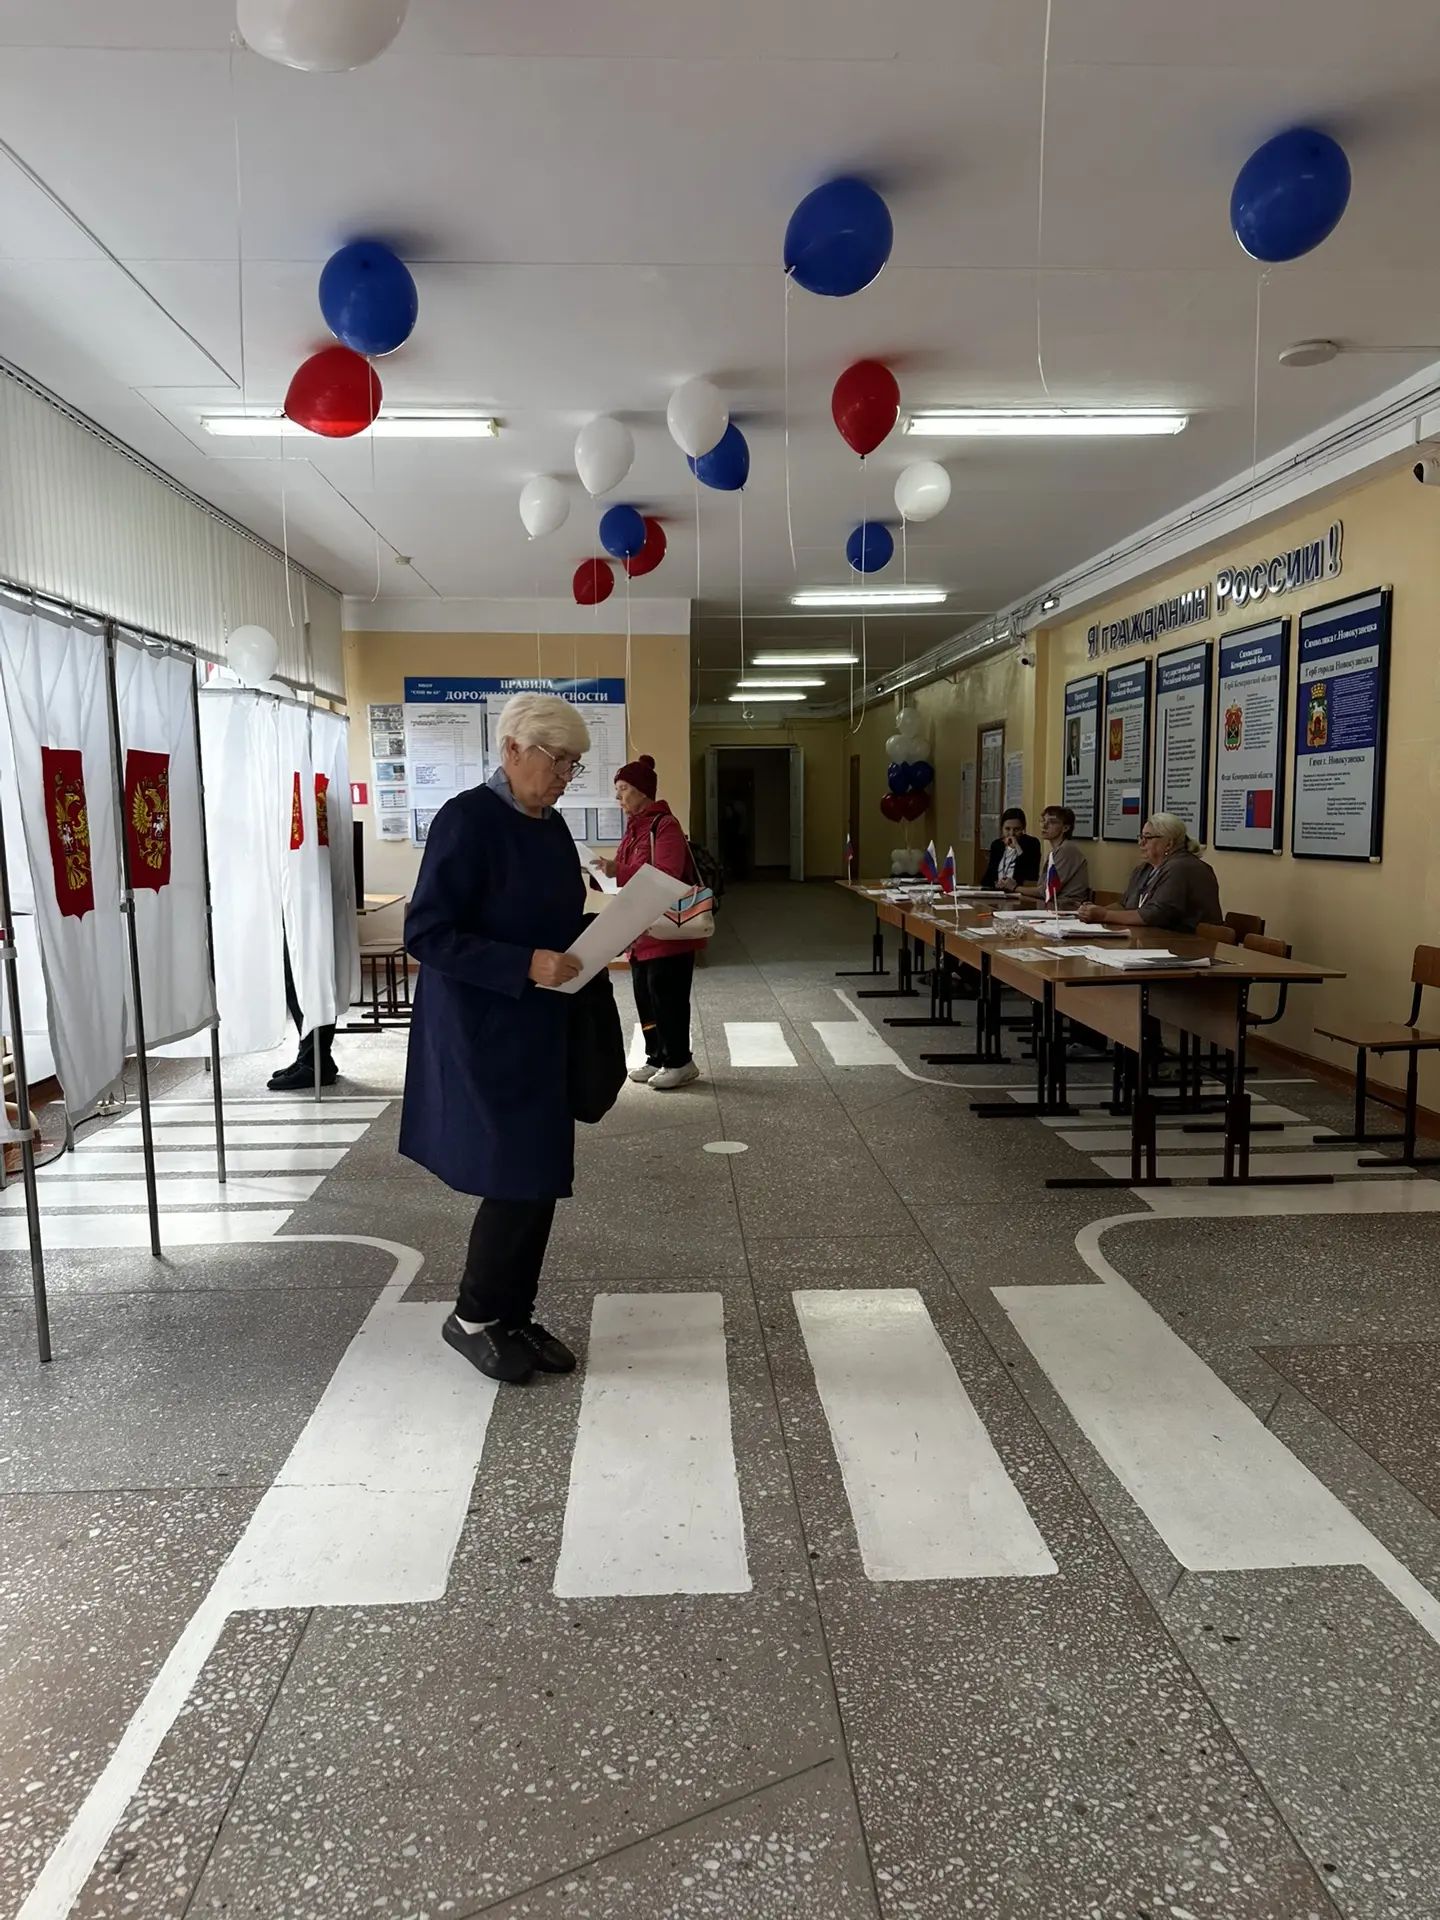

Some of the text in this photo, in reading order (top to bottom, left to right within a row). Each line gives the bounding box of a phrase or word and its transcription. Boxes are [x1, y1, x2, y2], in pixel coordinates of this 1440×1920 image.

[1087, 623, 1100, 661] Я
[1101, 583, 1211, 656] ГРАЖДАНИН
[1304, 634, 1333, 648] Символика
[500, 679, 553, 689] ПРАВИЛА
